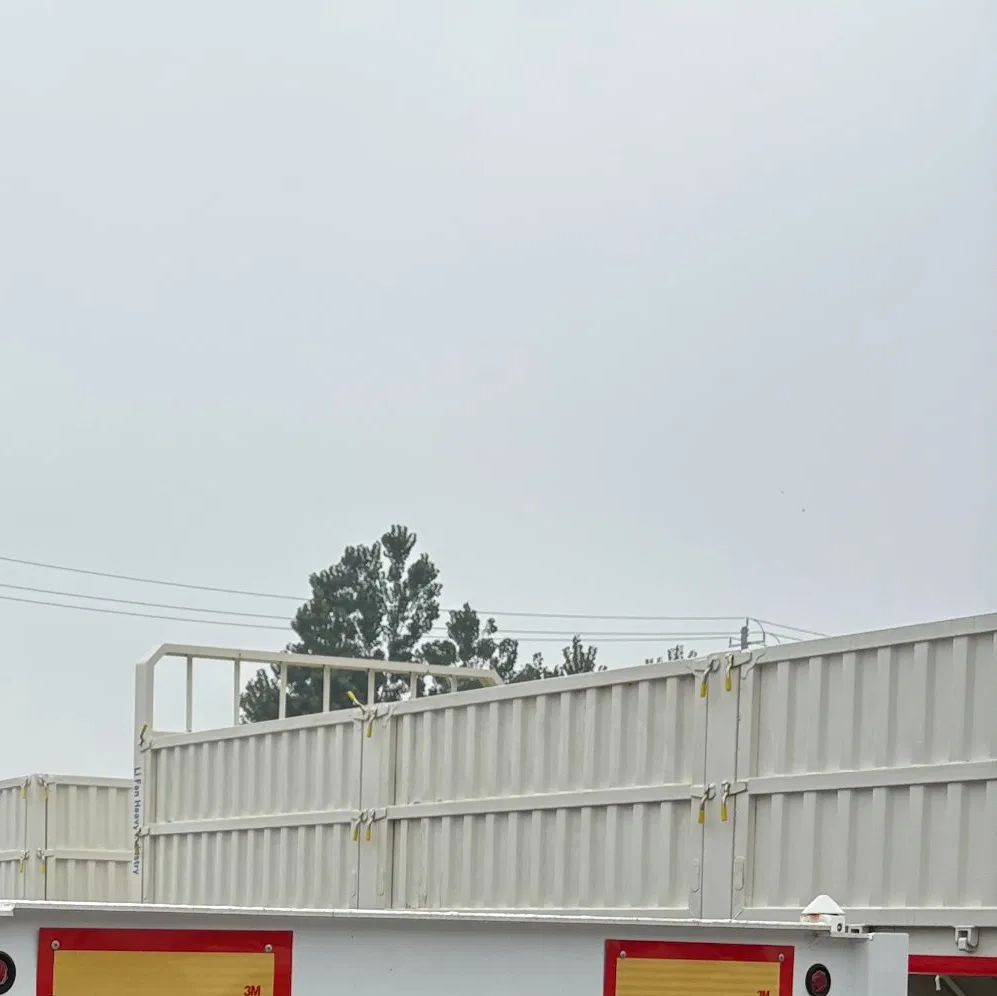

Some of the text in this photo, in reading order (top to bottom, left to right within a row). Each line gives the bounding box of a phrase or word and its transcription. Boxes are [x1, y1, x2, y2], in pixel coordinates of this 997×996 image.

[133, 779, 142, 797] Fan
[132, 800, 141, 830] Heavy
[243, 984, 261, 996] 3M
